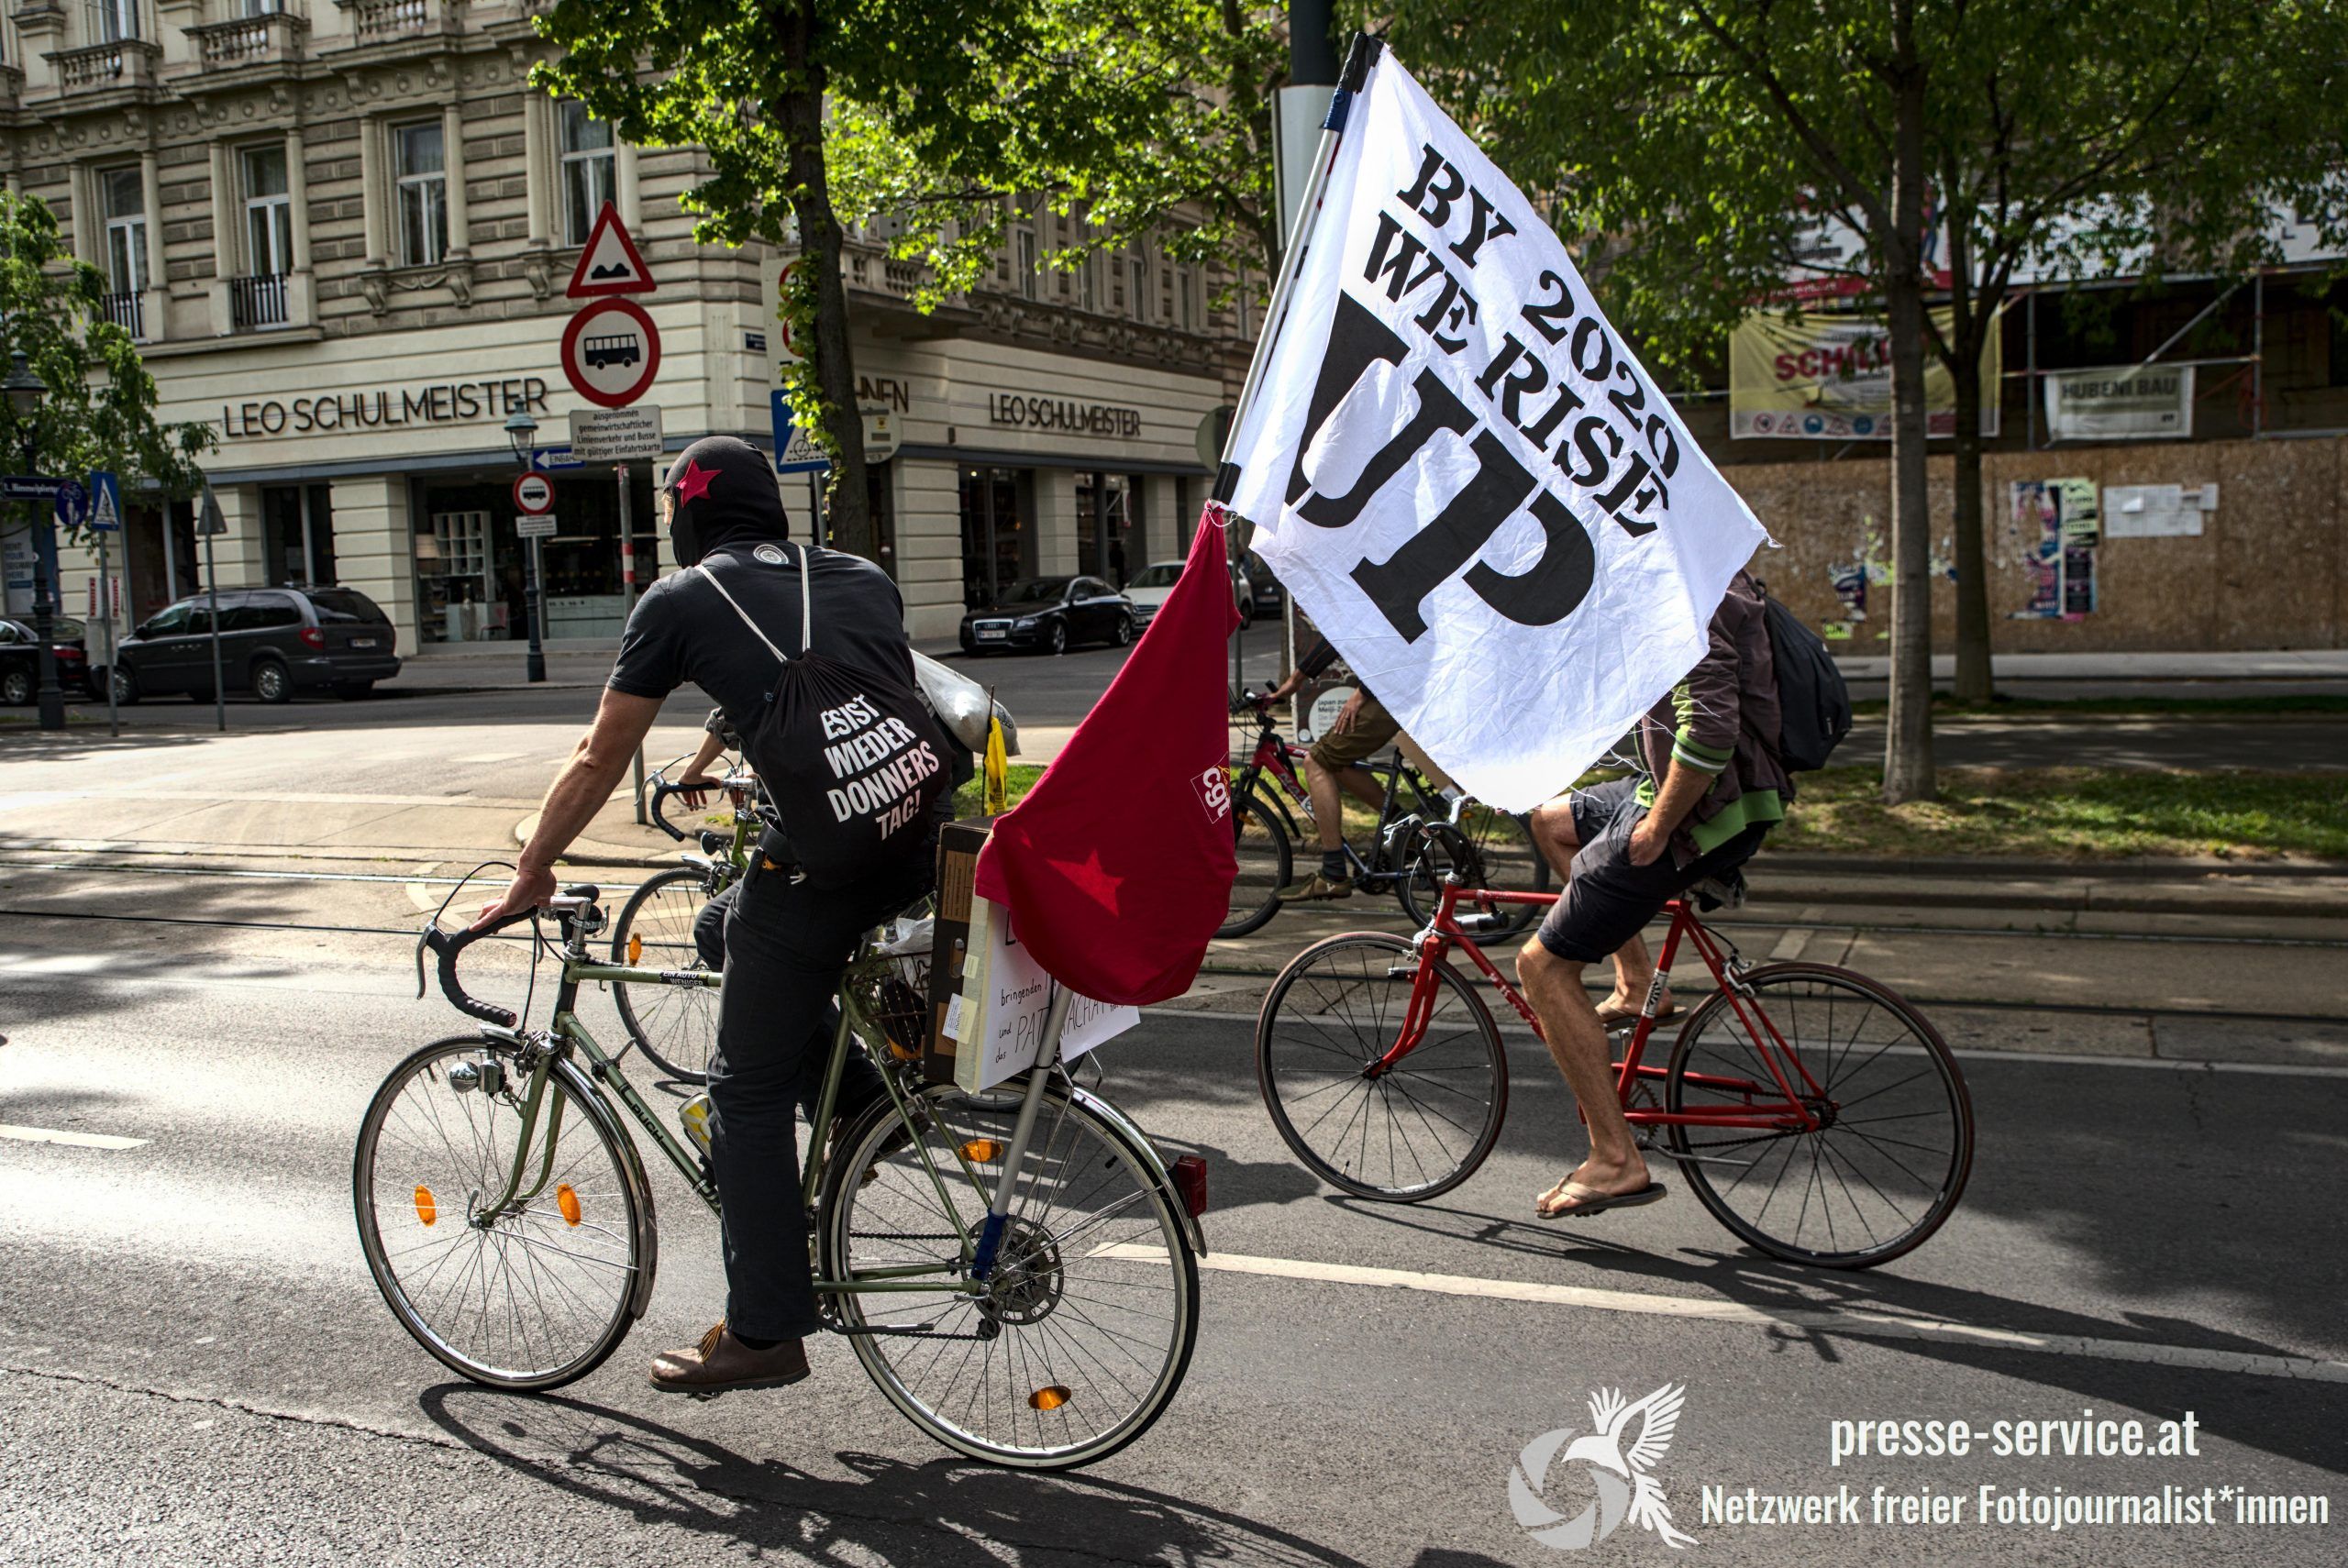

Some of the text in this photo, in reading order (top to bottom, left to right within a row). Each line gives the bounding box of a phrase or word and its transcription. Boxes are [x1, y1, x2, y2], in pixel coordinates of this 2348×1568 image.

[1396, 142, 1680, 480] BY 2020
[1363, 209, 1670, 538] WE RISE
[2136, 377, 2177, 396] BAU
[224, 377, 549, 439] LEO SCHULMEISTER
[593, 409, 639, 421] ausgenommen
[990, 392, 1140, 437] LEO SCHULMEISTER
[577, 431, 656, 444] Linienverkehr und Busse
[578, 420, 654, 434] gemeinwirtschaftlicher
[574, 443, 661, 457] mit gültiger Einfahrtskarte
[1284, 289, 1596, 646] UP
[824, 717, 917, 779] WIEDER
[826, 740, 939, 823] DONNERS
[875, 789, 921, 841] TAG!
[670, 977, 704, 987] WENIGER
[1001, 977, 1043, 1007] bringenden
[999, 1021, 1013, 1040] und
[995, 1046, 1007, 1064] das
[631, 1105, 664, 1143] PUCH
